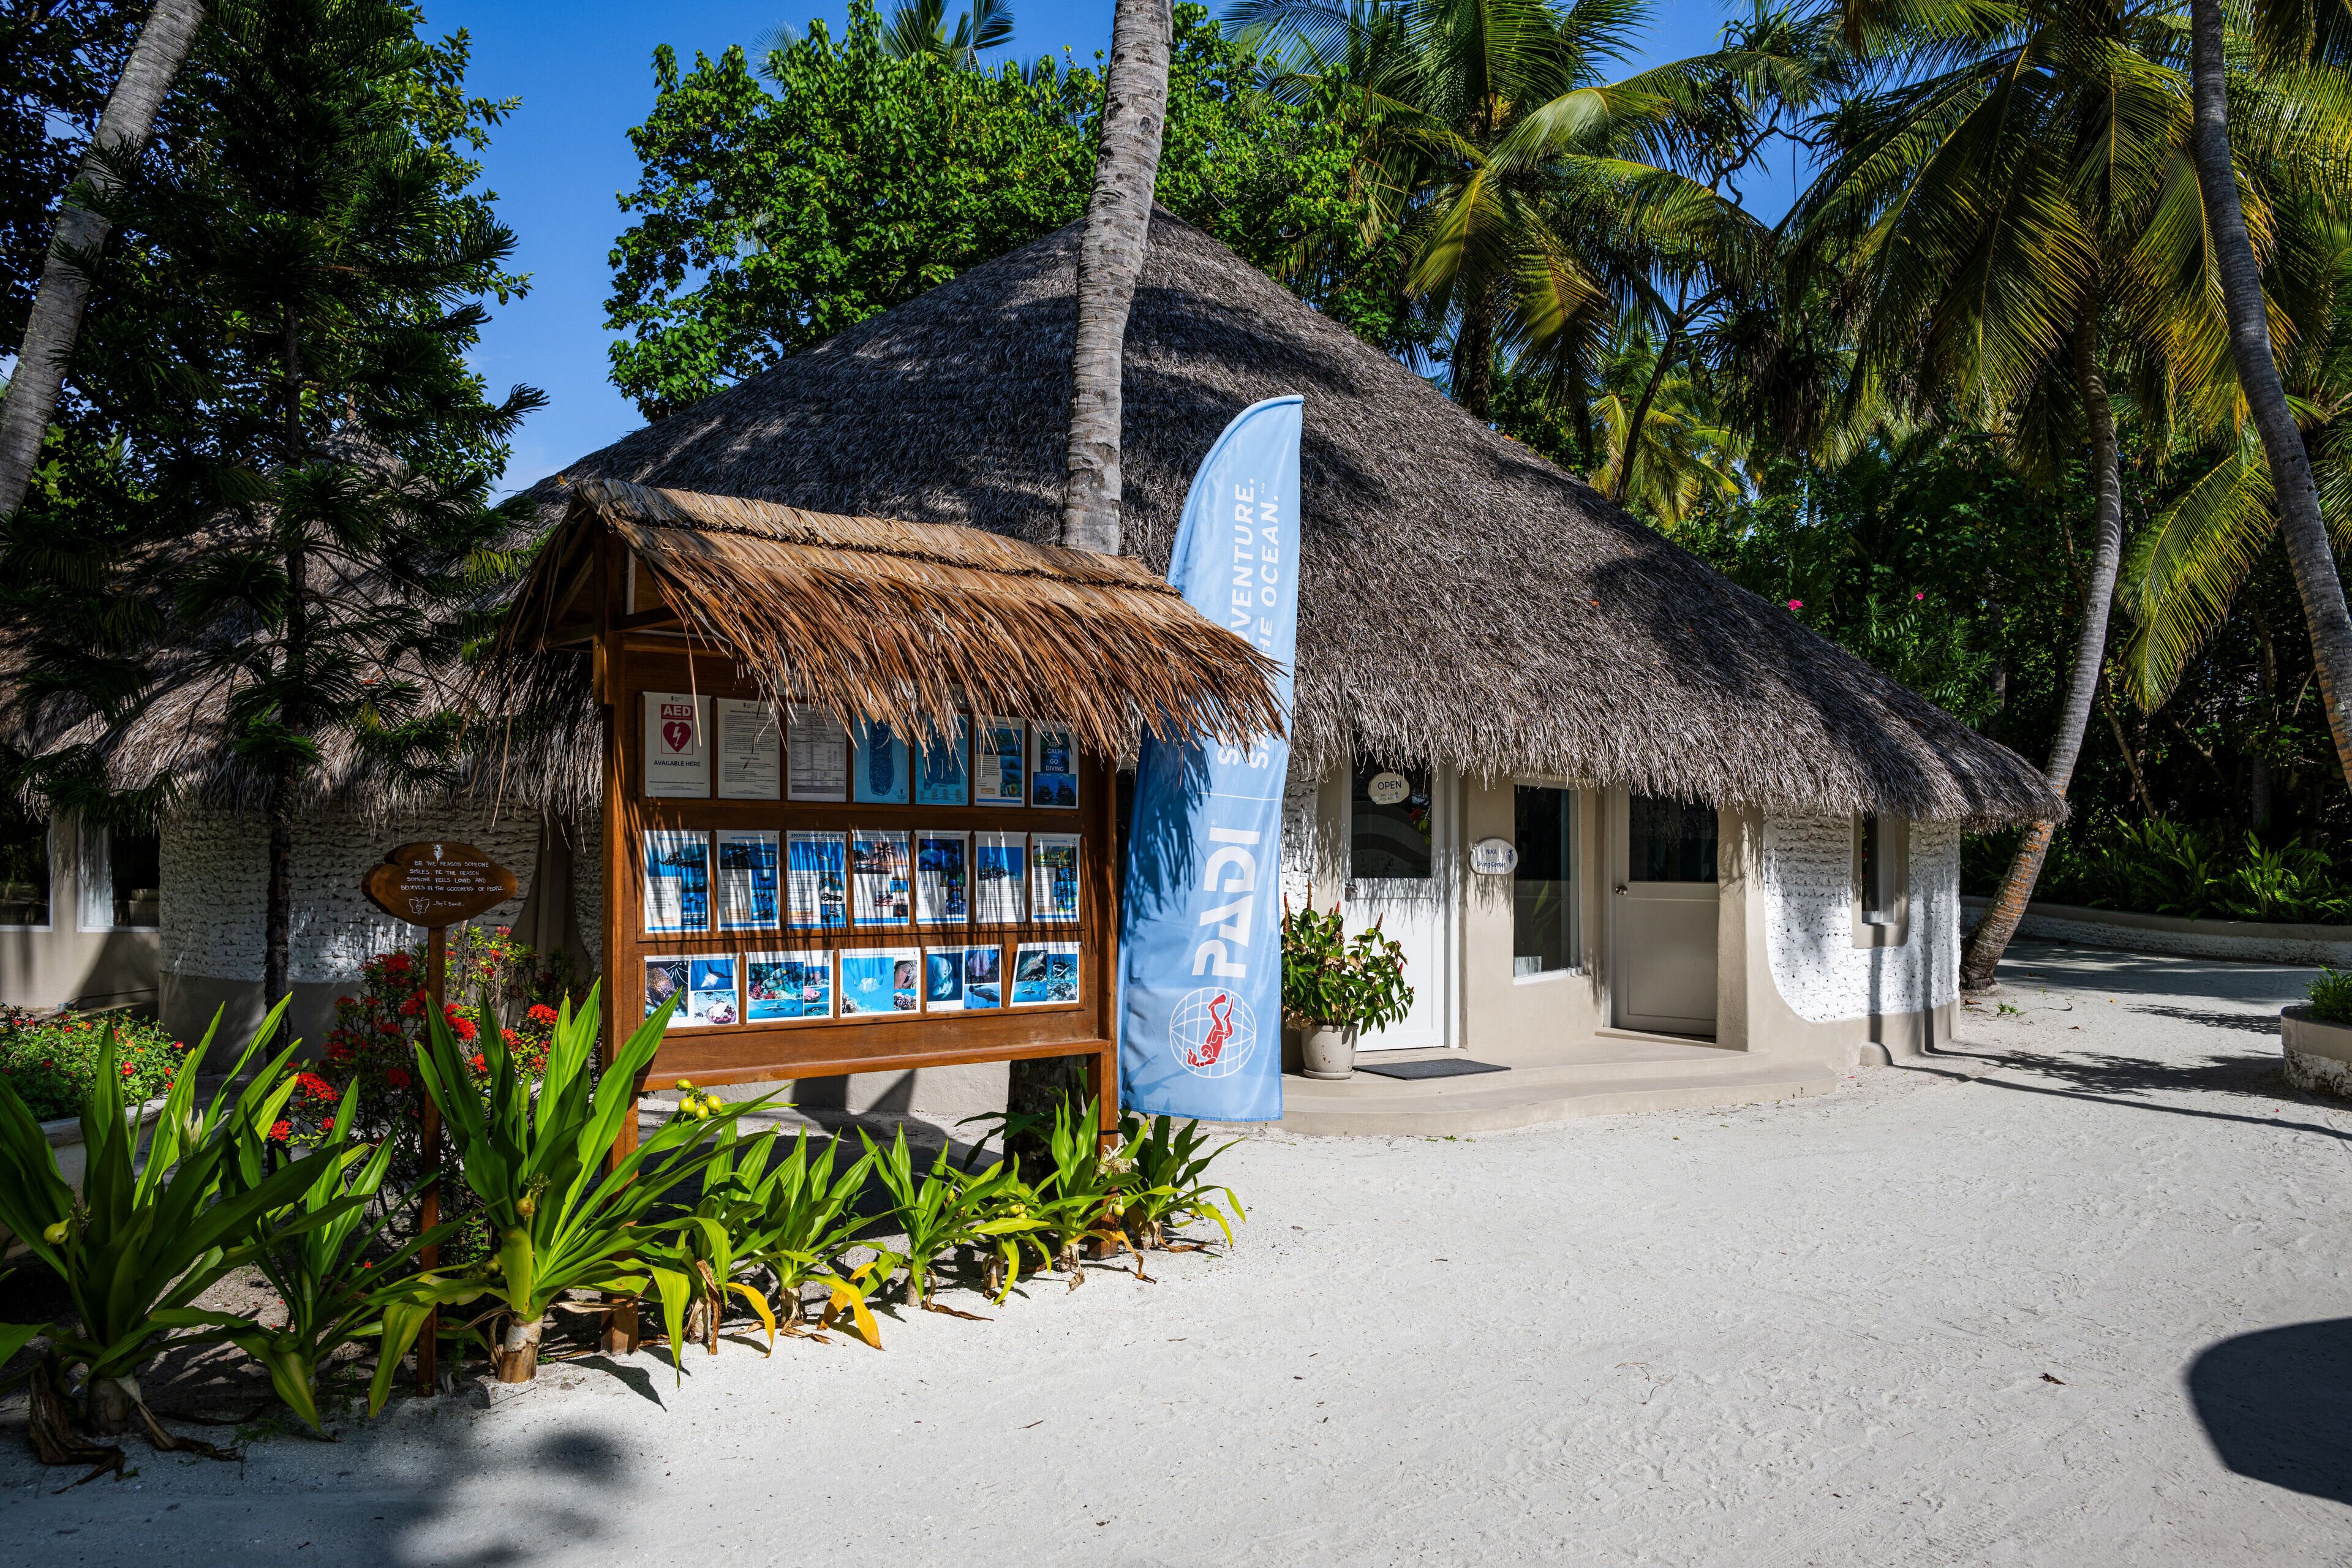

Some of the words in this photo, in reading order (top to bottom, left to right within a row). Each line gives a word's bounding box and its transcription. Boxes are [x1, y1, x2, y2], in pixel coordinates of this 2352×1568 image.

[1260, 495, 1278, 607] OCEAN.
[663, 705, 692, 717] AED
[1378, 780, 1401, 790] OPEN
